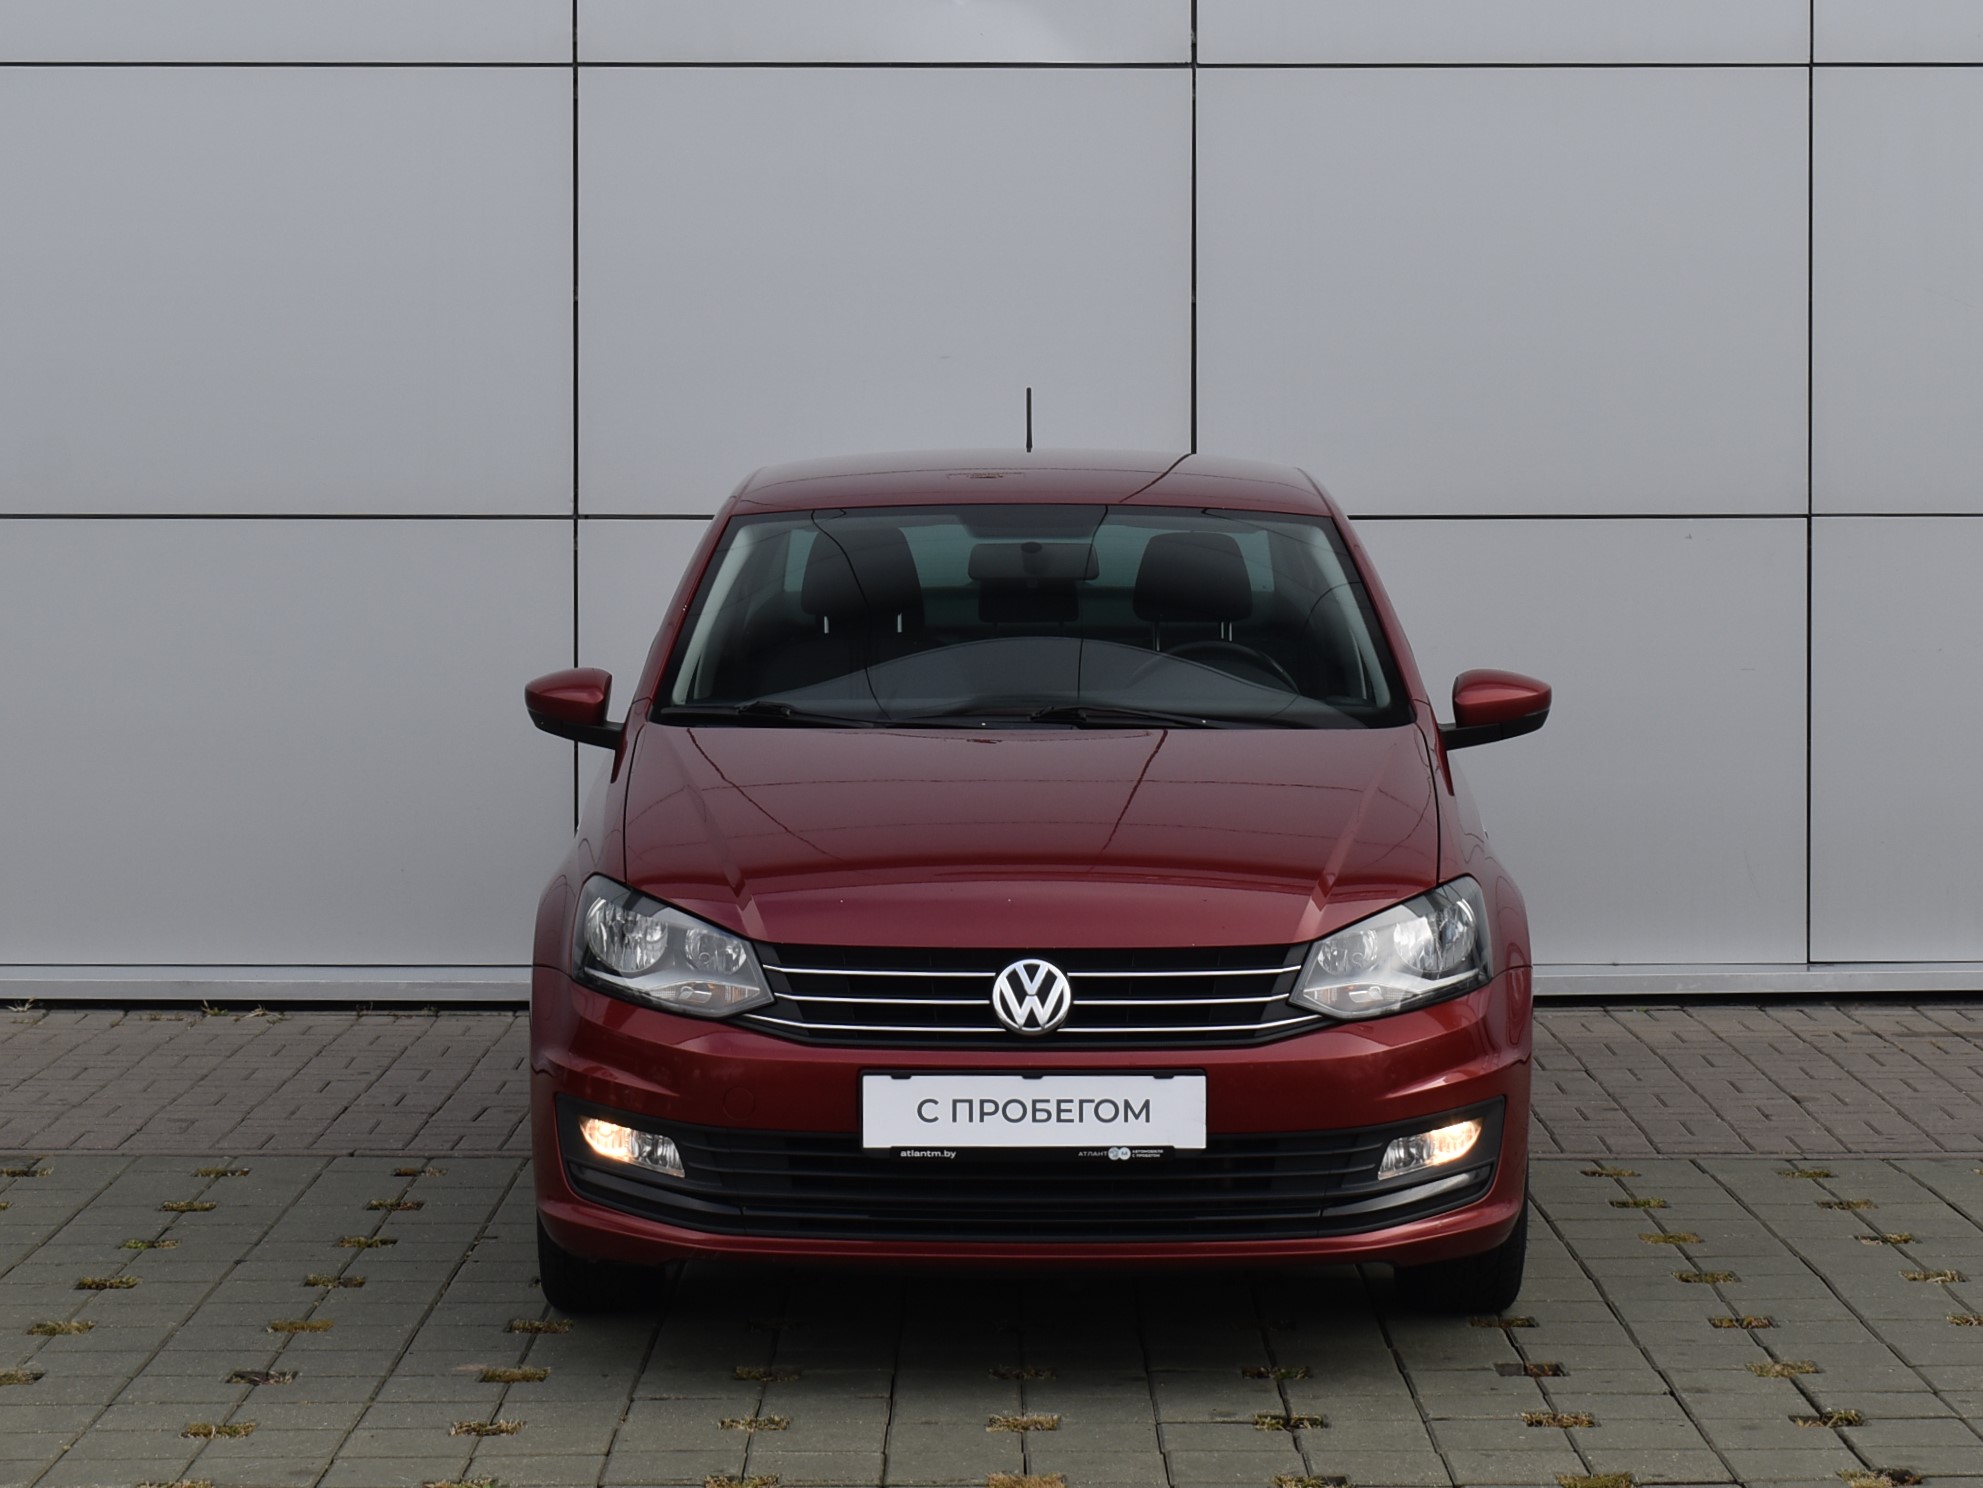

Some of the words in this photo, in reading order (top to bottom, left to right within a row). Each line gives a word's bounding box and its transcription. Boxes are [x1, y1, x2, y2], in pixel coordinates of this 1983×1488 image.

[917, 1098, 939, 1123] С
[952, 1098, 1150, 1123] ПРОБЕГОМ
[900, 1150, 956, 1159] atlantm.by
